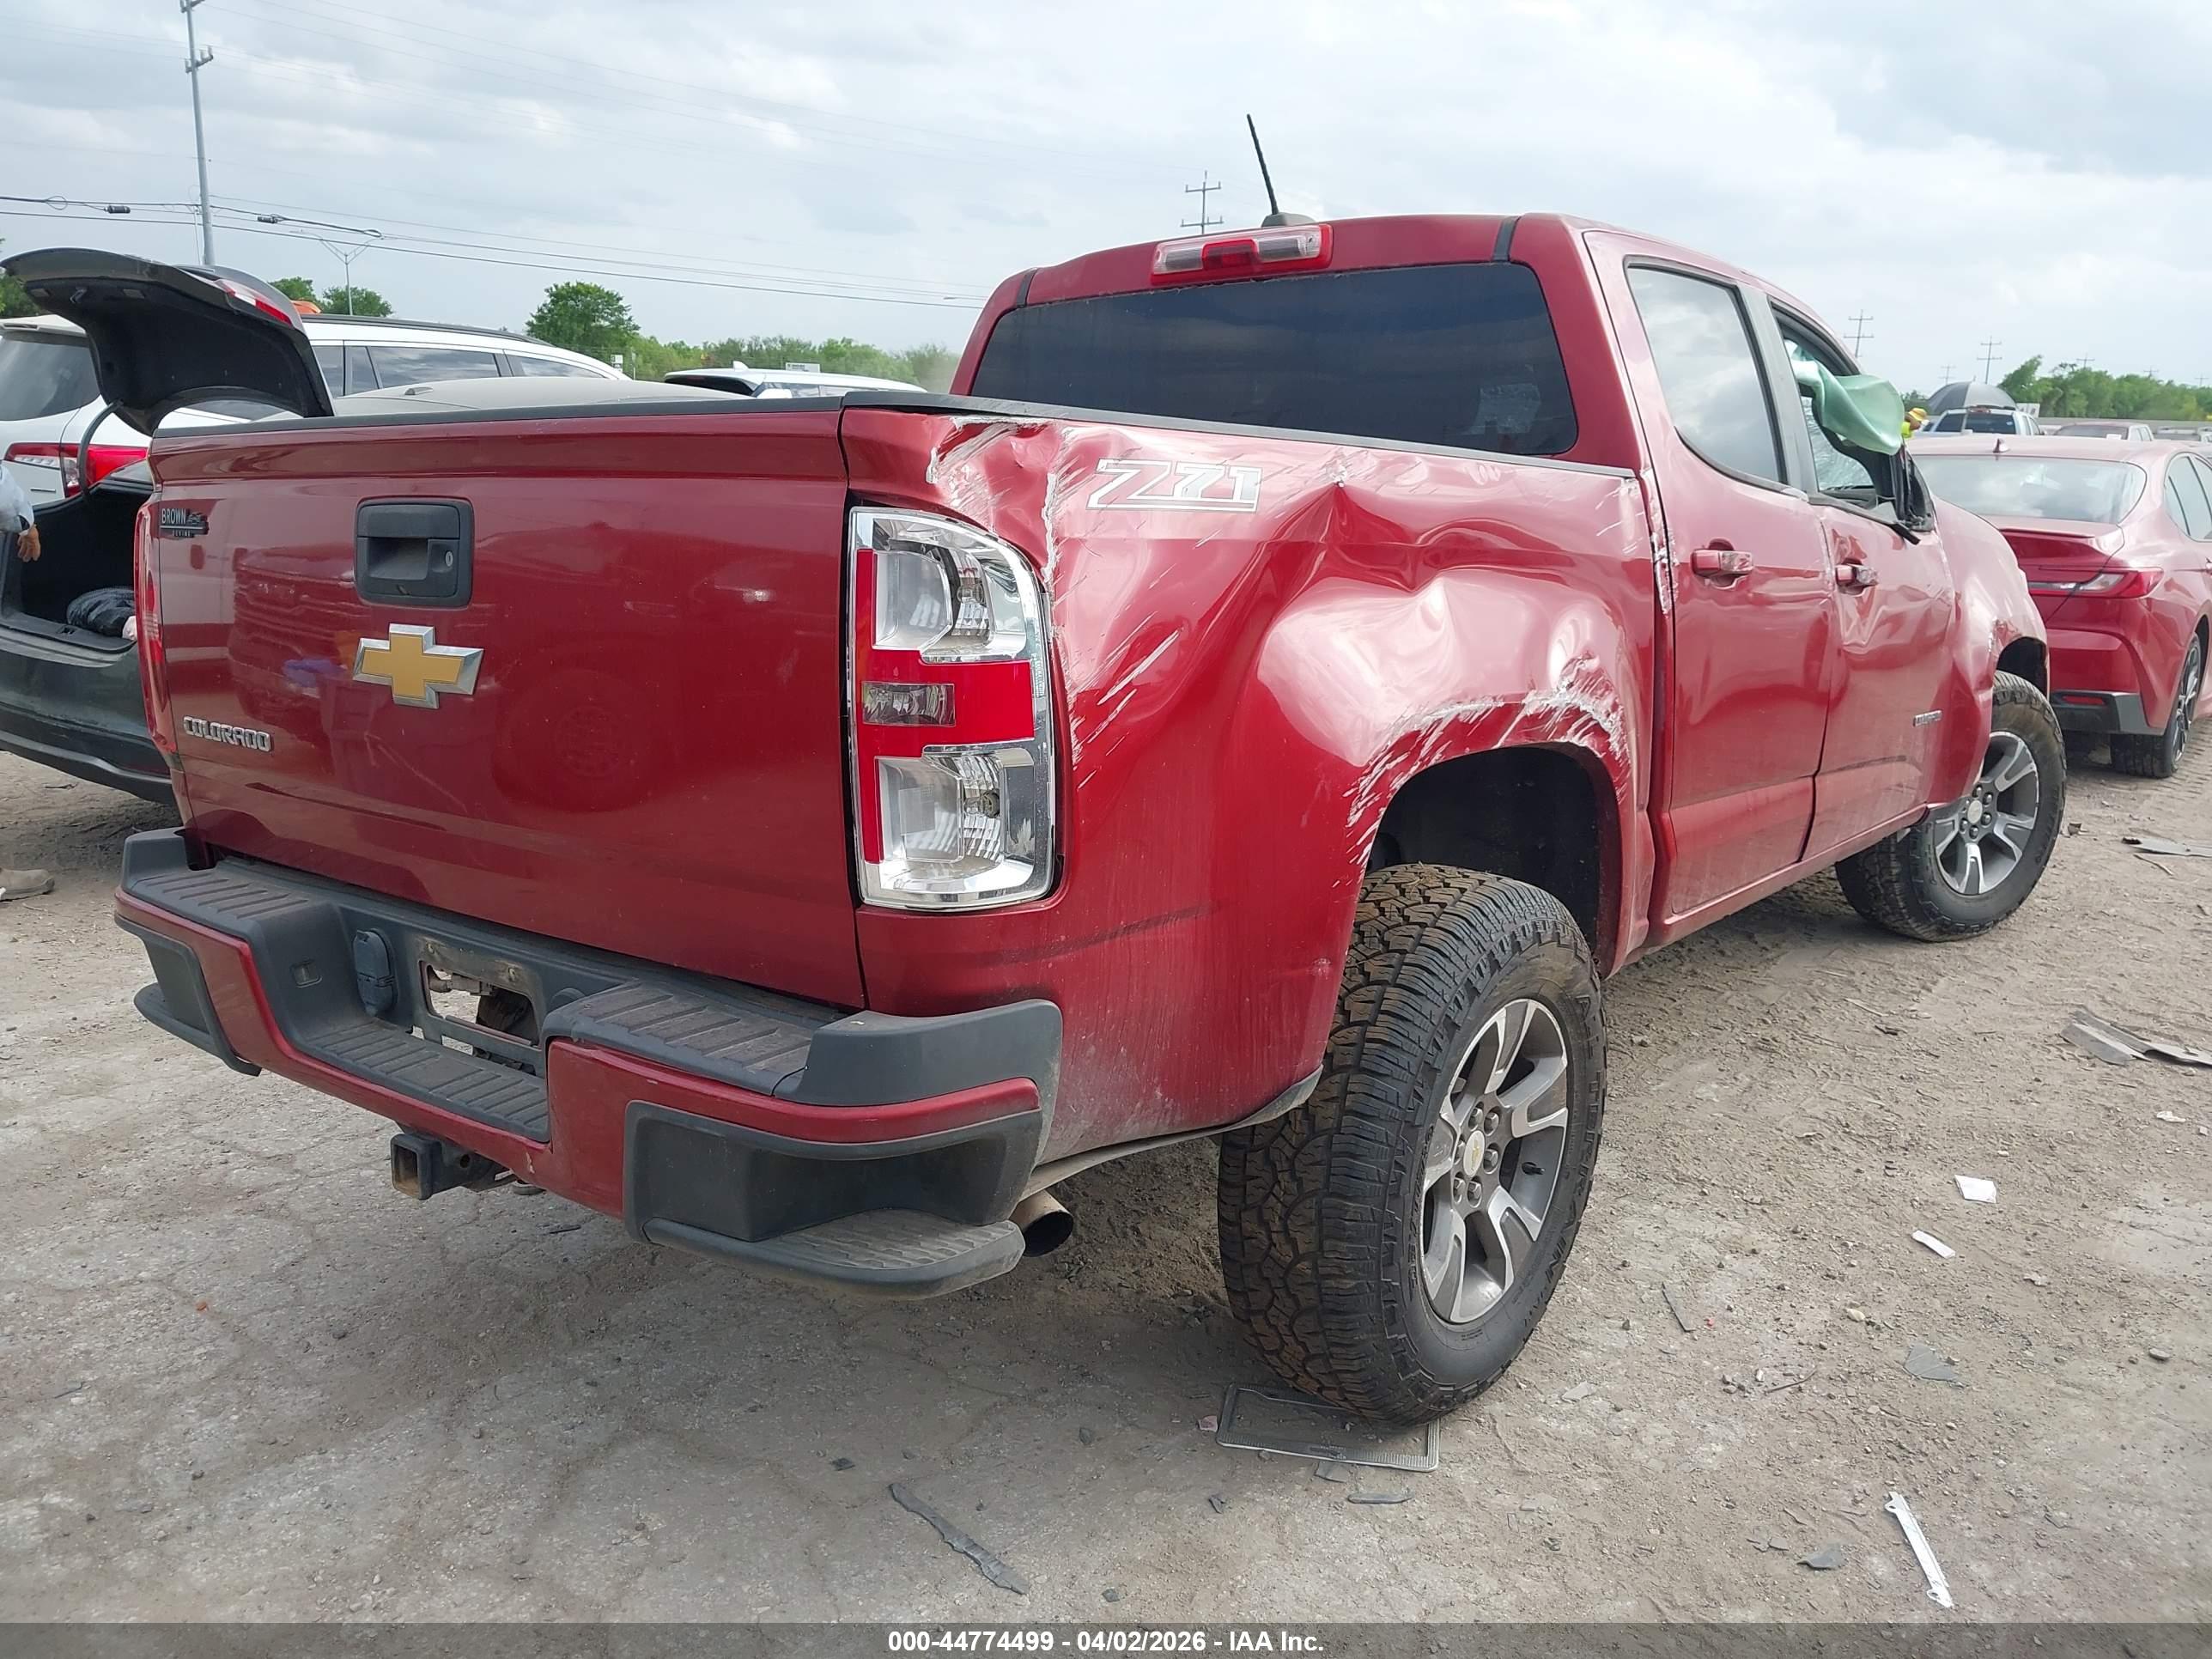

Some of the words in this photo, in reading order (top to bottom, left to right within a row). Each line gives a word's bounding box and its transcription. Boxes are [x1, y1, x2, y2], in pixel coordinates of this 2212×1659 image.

[1085, 458, 1263, 513] Z71
[161, 507, 186, 524] BROWN
[183, 716, 271, 752] COLORADO
